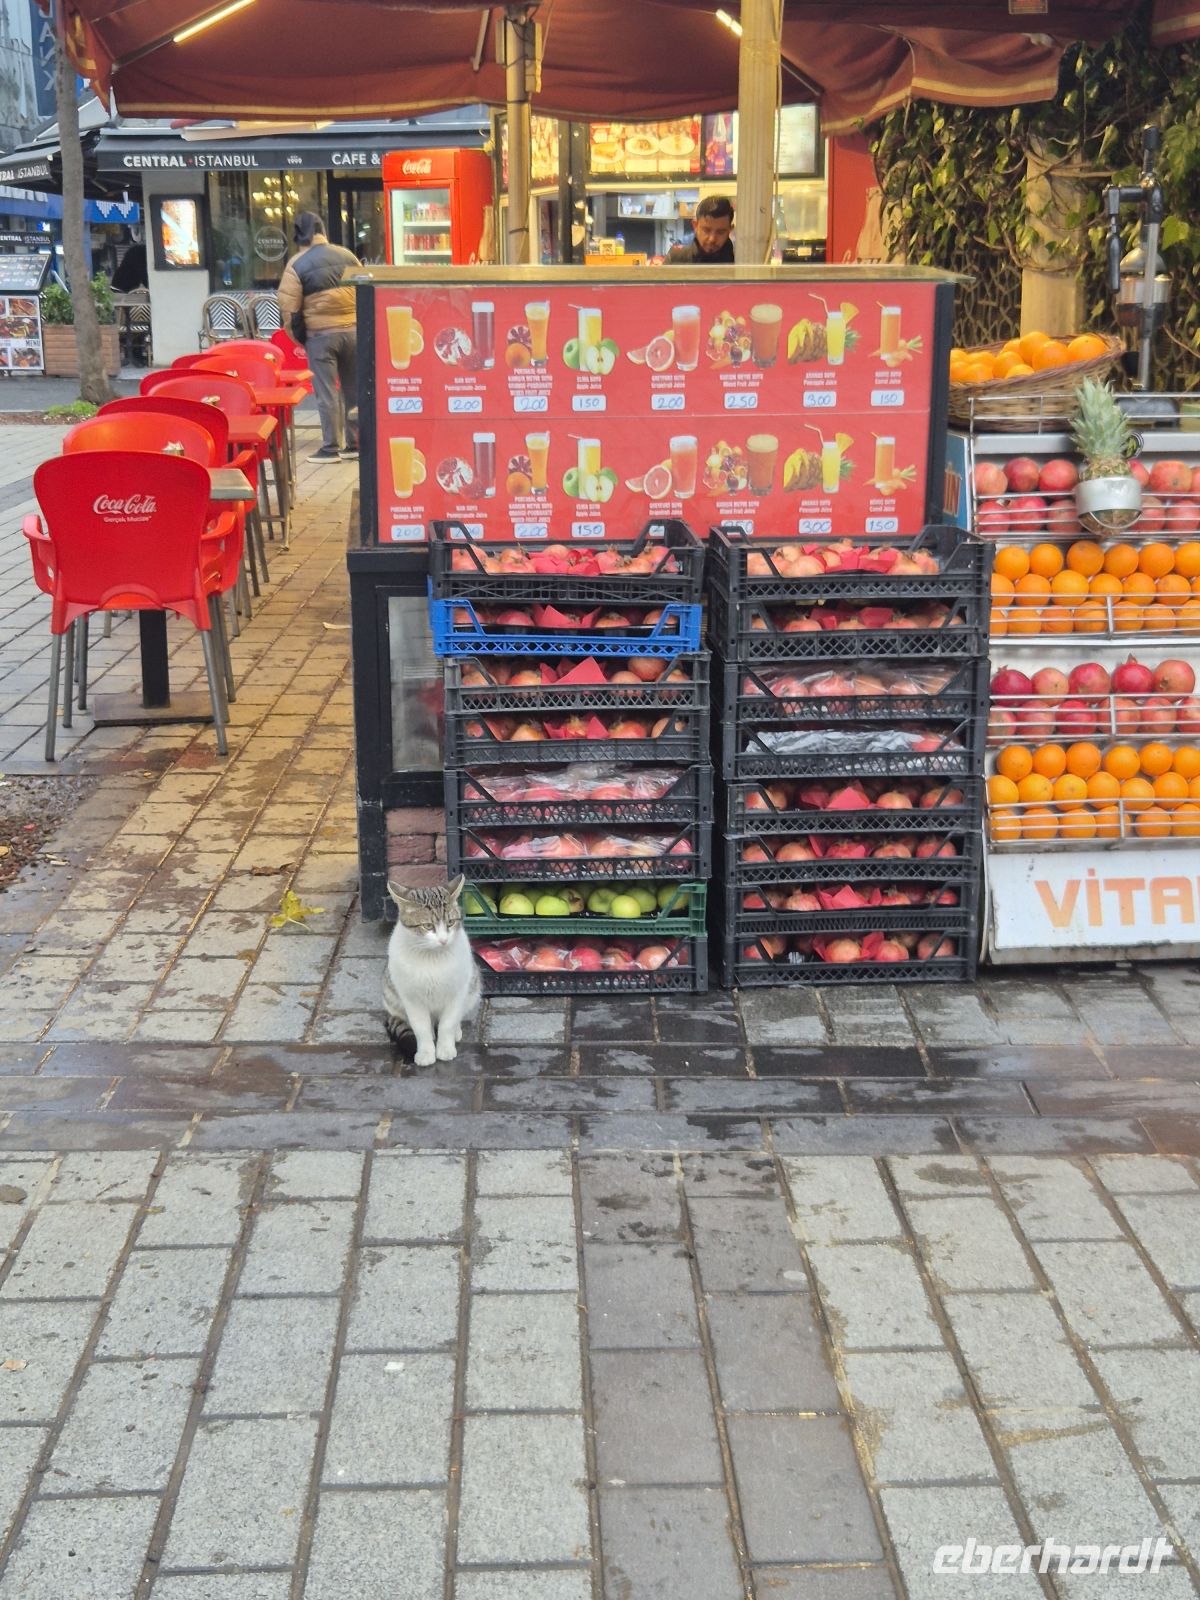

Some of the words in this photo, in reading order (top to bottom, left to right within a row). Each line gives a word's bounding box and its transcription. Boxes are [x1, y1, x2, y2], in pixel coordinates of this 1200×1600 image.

[124, 156, 186, 167] CENTRAL
[194, 156, 258, 166] ISTANBUL
[332, 154, 366, 165] CAFE
[370, 154, 380, 164] &
[18, 164, 48, 179] ISTANBUL
[521, 398, 546, 410] 200
[579, 399, 600, 408] 150
[658, 396, 683, 408] 200
[727, 396, 756, 407] 250
[807, 394, 831, 406] 300
[880, 393, 898, 404] 150
[395, 400, 422, 411] 200
[453, 400, 480, 410] 200
[517, 526, 547, 536] 200
[578, 525, 602, 536] 150
[802, 521, 830, 532] 300
[870, 520, 894, 531] 150
[396, 527, 420, 537] 200
[1034, 868, 1200, 928] VİTA
